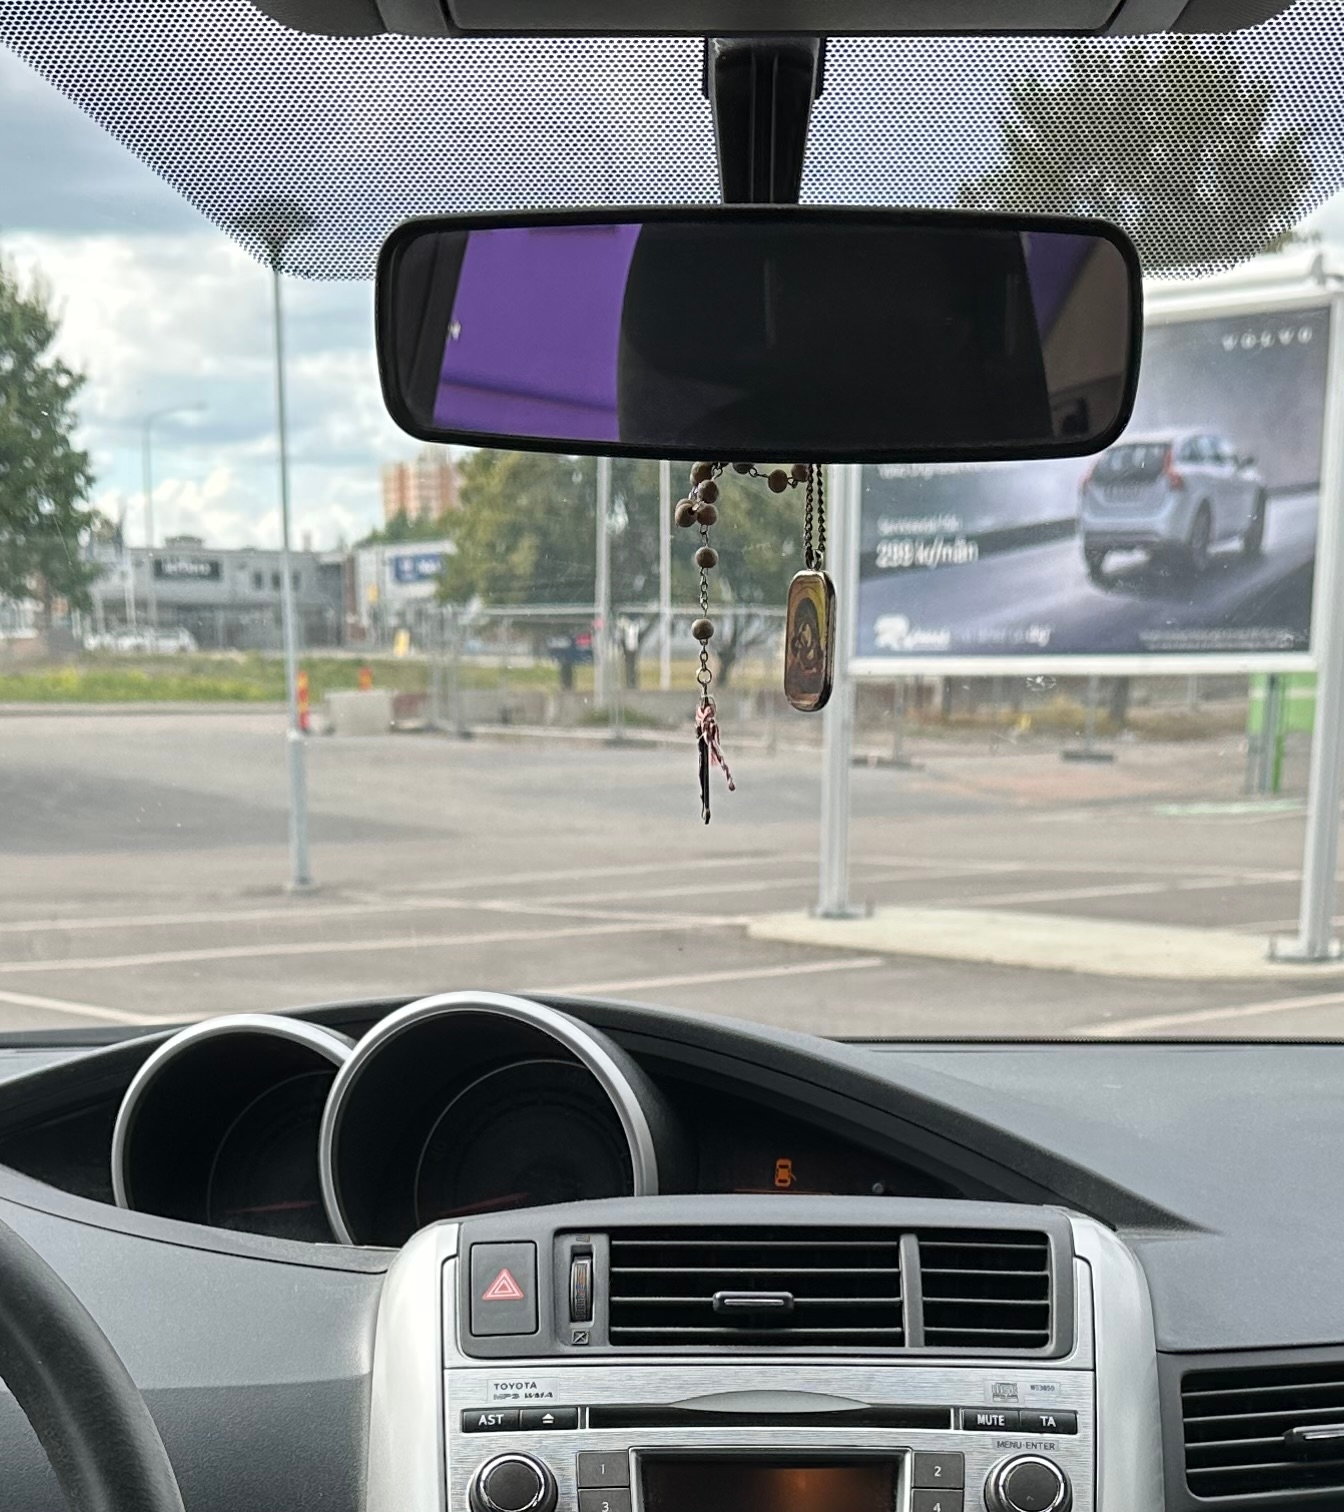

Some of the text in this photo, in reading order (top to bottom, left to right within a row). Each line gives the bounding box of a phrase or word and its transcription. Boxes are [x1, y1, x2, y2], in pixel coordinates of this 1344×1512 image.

[493, 1381, 537, 1391] TOYOTA
[478, 1414, 504, 1426] AST
[977, 1414, 1005, 1427] MUTE
[1039, 1415, 1057, 1428] TA
[599, 1464, 605, 1474] 1
[934, 1466, 942, 1477] 2
[601, 1501, 609, 1512] 3
